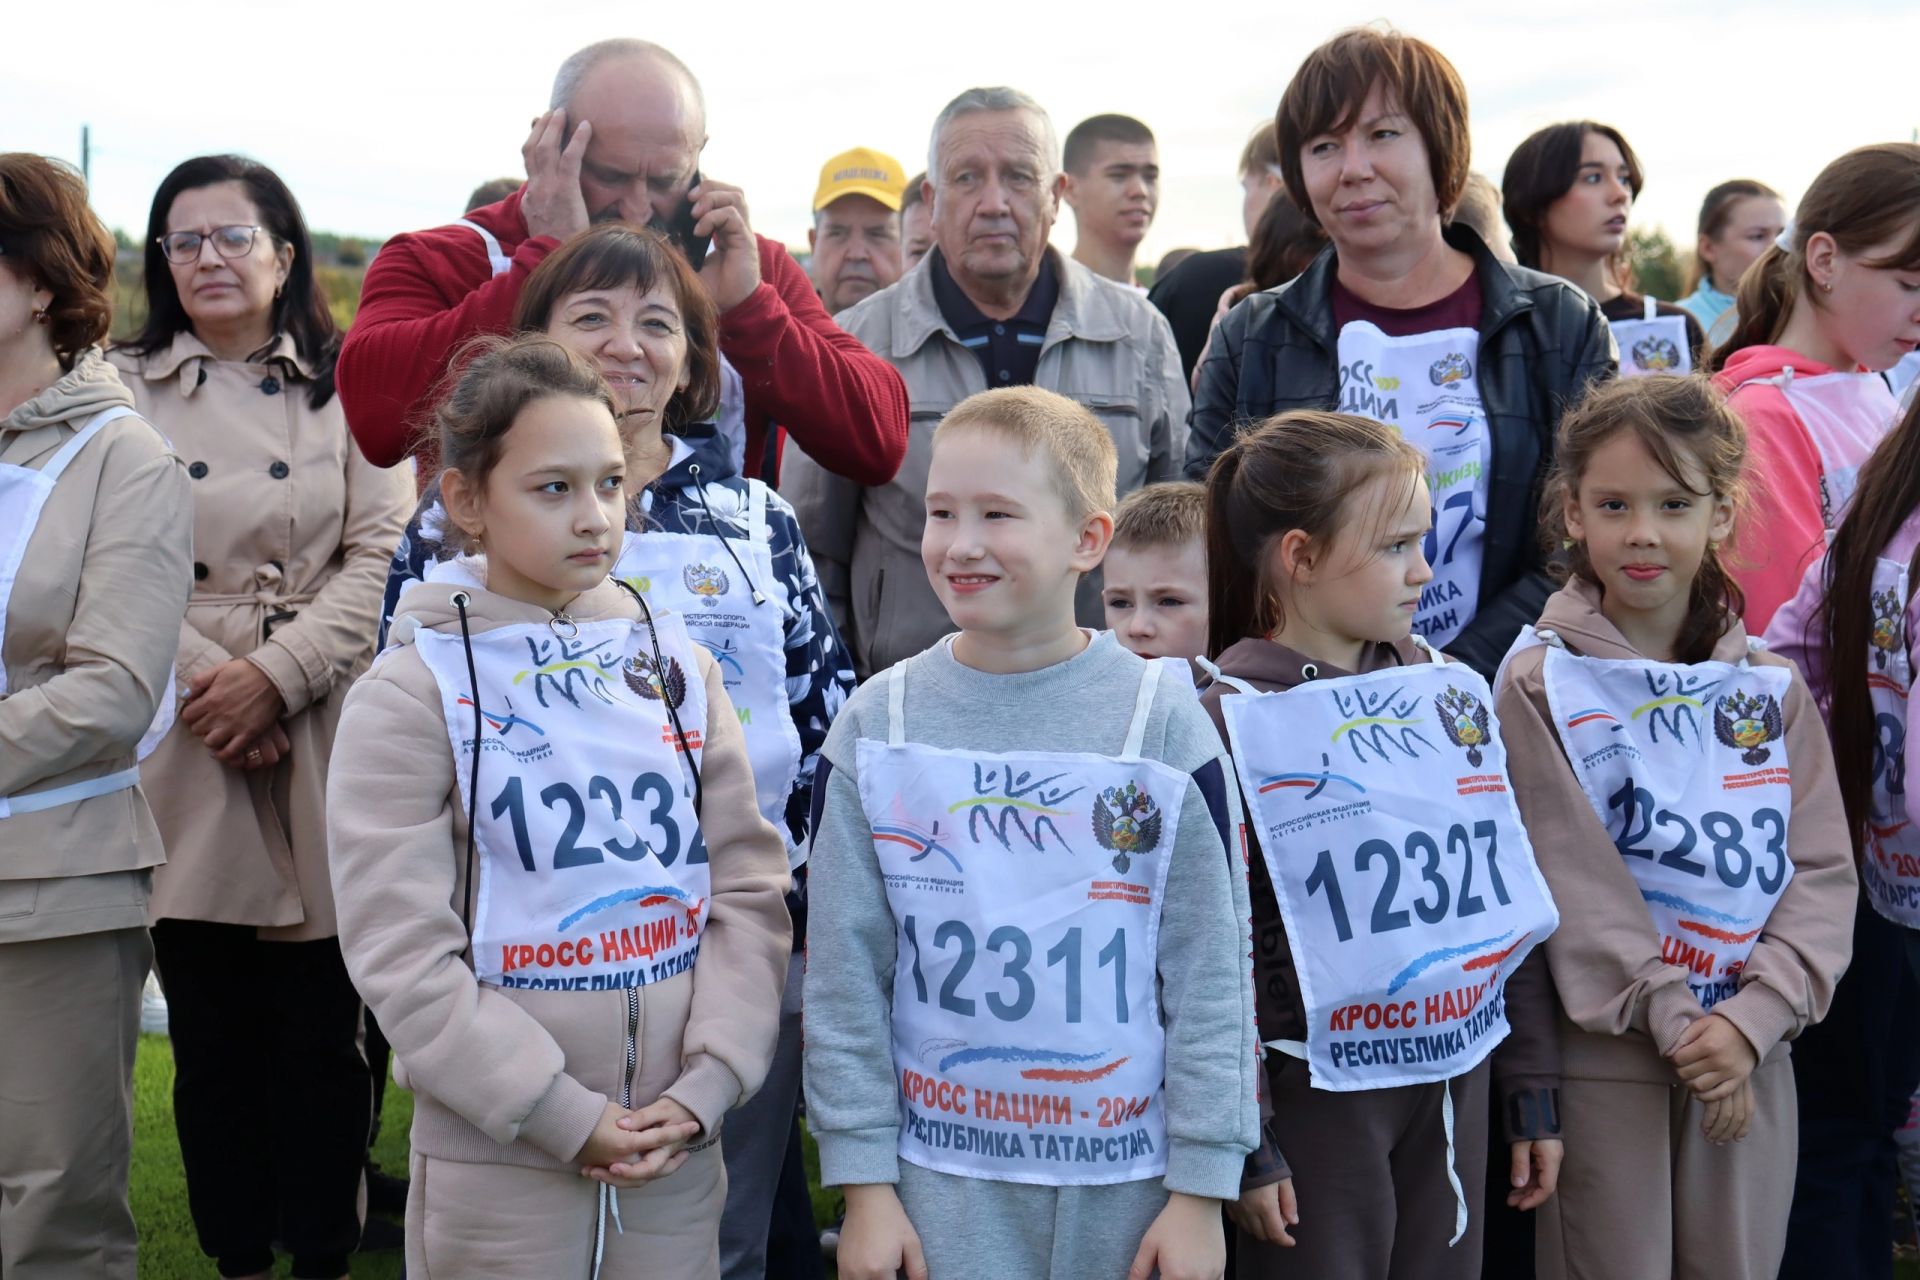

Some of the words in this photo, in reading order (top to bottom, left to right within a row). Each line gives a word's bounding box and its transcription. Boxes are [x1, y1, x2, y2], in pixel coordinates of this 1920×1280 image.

[714, 621, 750, 629] ФЕДЕРАЦИИ
[1269, 808, 1331, 833] ВСЕРОССИЙСКАЯ
[1331, 800, 1371, 814] ФЕДЕРАЦИЯ
[1272, 821, 1313, 840] ЛЕГКОЙ
[1320, 806, 1373, 825] АТЛЕТИКИ
[1609, 777, 1786, 895] 12283
[916, 884, 964, 895] АТЛЕТИКИ
[1305, 820, 1512, 942] 12327
[502, 939, 595, 973] КРОСС
[602, 914, 677, 962] НАЦИИ
[903, 914, 1129, 1024] 12311
[1329, 1000, 1417, 1032] КРОСС
[1329, 1027, 1466, 1068] РЕСПУБЛИКА
[902, 1068, 967, 1115] КРОСС
[974, 1088, 1072, 1129] НАЦИИ
[906, 1107, 1026, 1158] РЕСПУБЛИКА
[1029, 1127, 1155, 1163] ТАТАРСТАН
